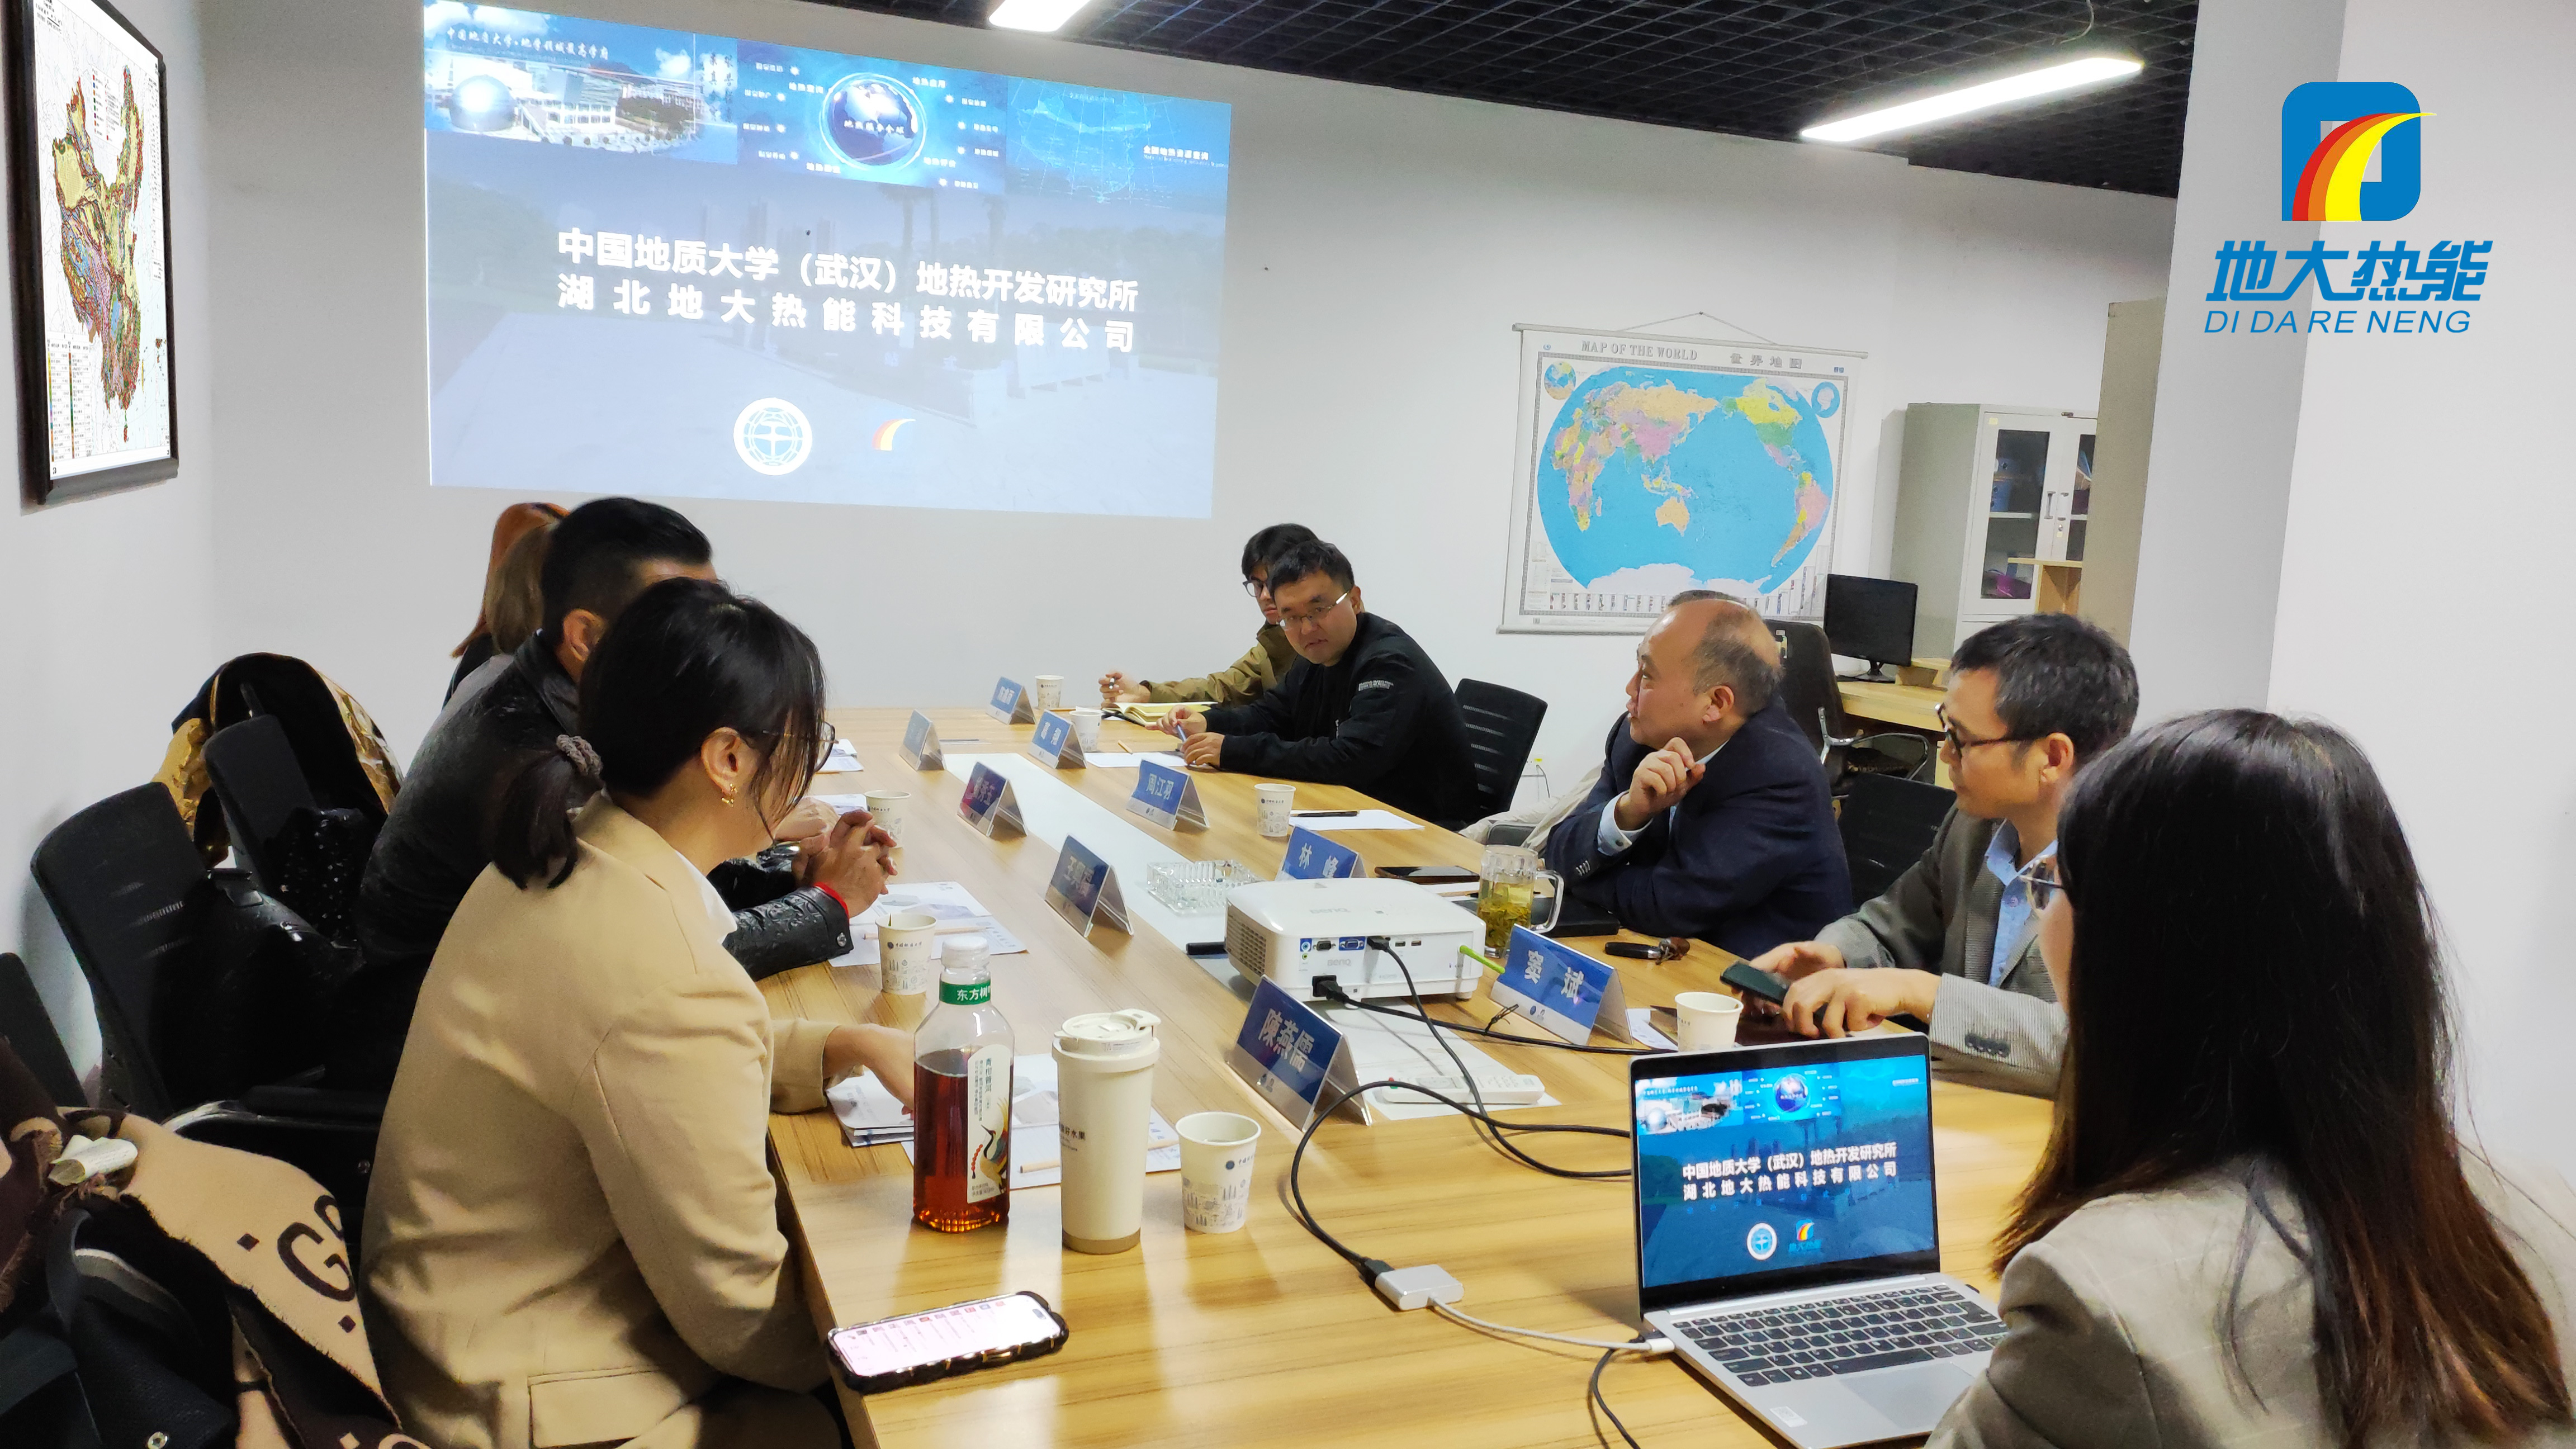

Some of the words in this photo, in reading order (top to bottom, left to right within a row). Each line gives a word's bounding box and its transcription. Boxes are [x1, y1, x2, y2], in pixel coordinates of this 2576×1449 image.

[1581, 340, 1608, 354] MAP
[1612, 343, 1626, 354] OF
[1630, 344, 1653, 357] THE
[1657, 347, 1698, 361] WORLD
[1730, 353, 1802, 370] 世界地图
